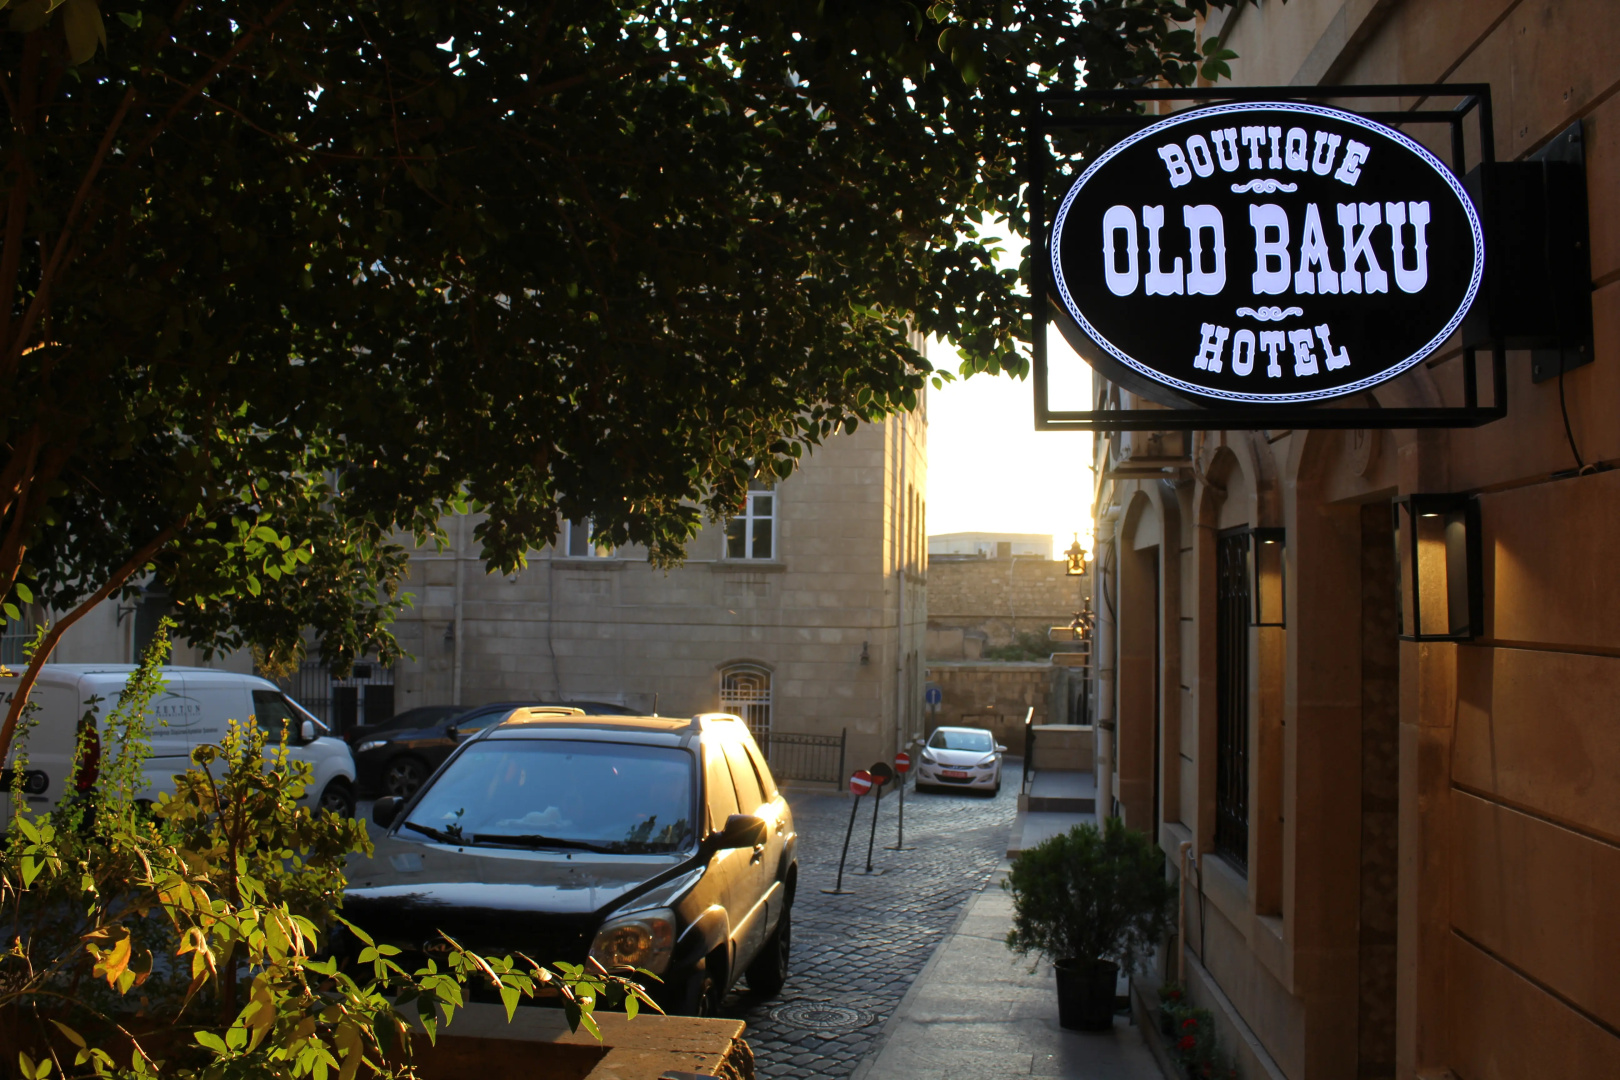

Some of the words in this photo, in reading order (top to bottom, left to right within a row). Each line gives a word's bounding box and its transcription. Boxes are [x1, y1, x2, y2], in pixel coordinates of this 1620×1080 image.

[1157, 125, 1371, 188] BOUTIQUE
[1102, 204, 1227, 297] OLD
[1249, 201, 1431, 295] BAKU
[1193, 323, 1351, 378] HOTEL
[155, 704, 201, 714] ZEYTUN
